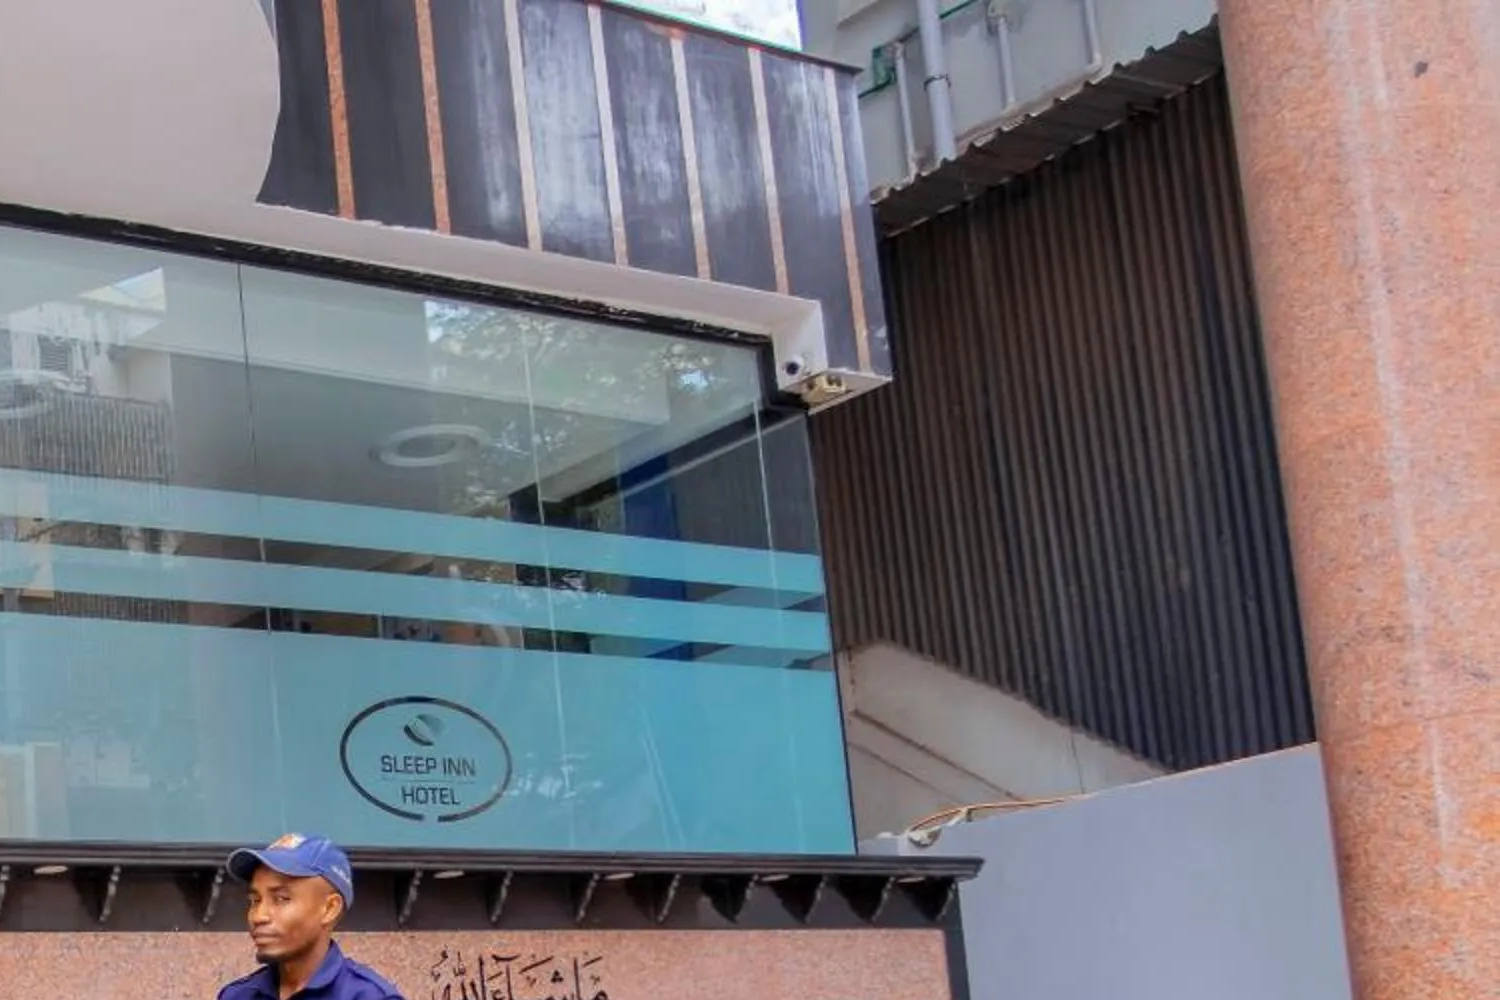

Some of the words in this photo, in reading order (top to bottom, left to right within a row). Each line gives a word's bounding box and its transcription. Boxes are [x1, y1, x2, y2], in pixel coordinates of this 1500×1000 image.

[381, 754, 437, 775] SLEEP
[443, 757, 476, 777] INN
[401, 785, 460, 805] HOTEL
